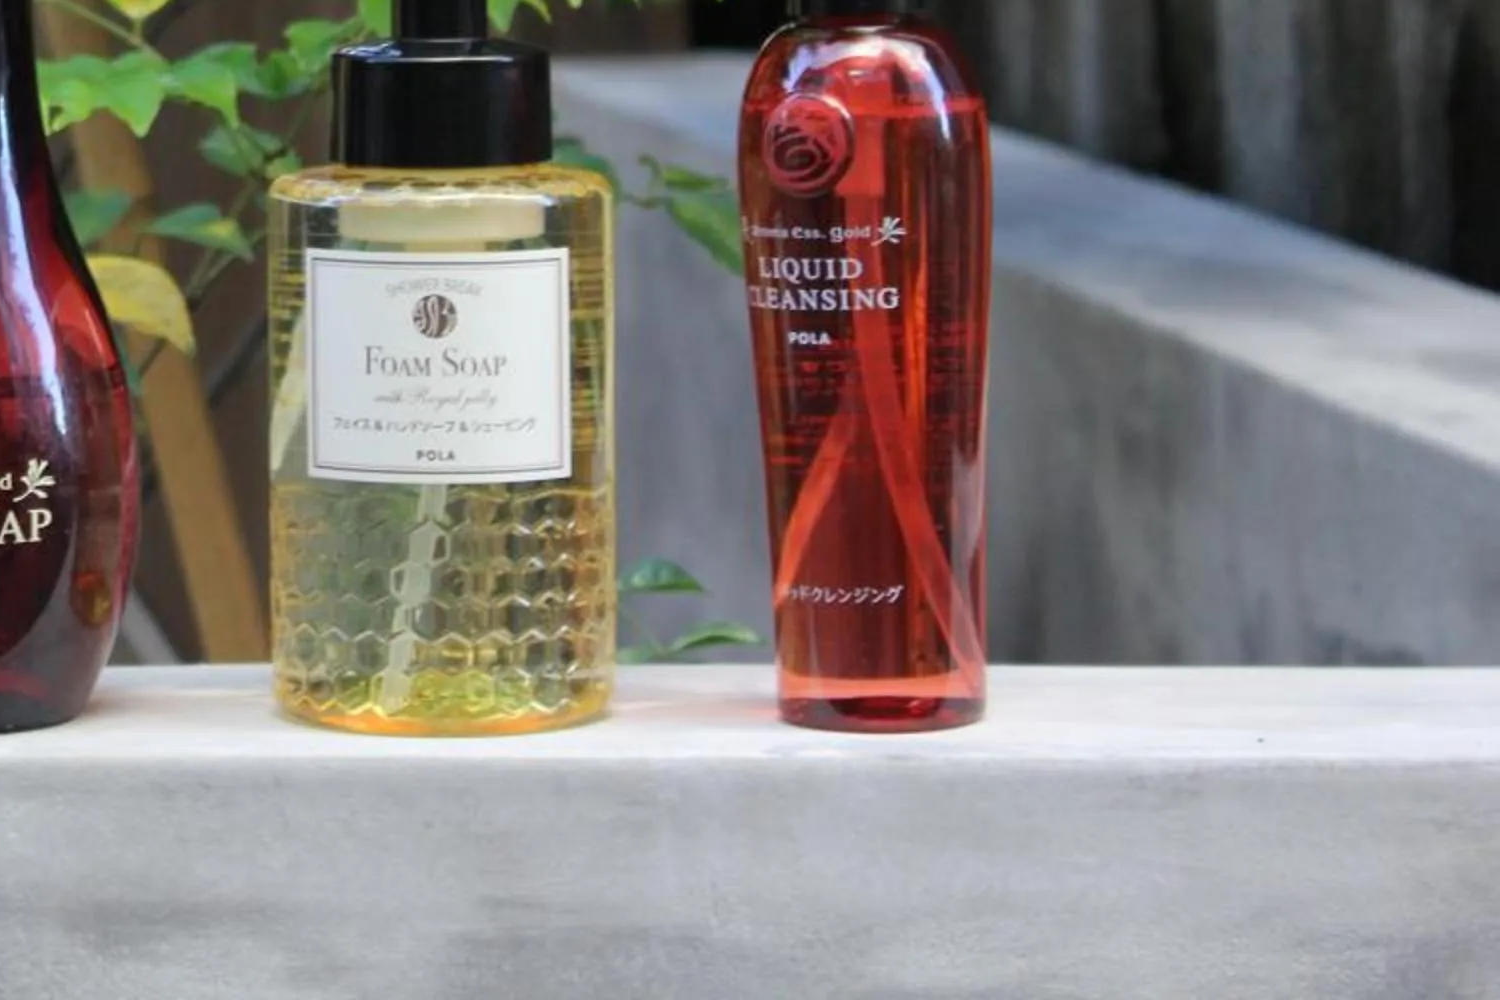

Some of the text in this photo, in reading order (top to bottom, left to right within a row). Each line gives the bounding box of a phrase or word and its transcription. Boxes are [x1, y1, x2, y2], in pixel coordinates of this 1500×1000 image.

[829, 225, 872, 243] gold
[758, 256, 864, 284] LIQUID
[749, 285, 901, 311] LEANSING
[788, 331, 832, 346] POLA
[416, 449, 456, 462] POLA
